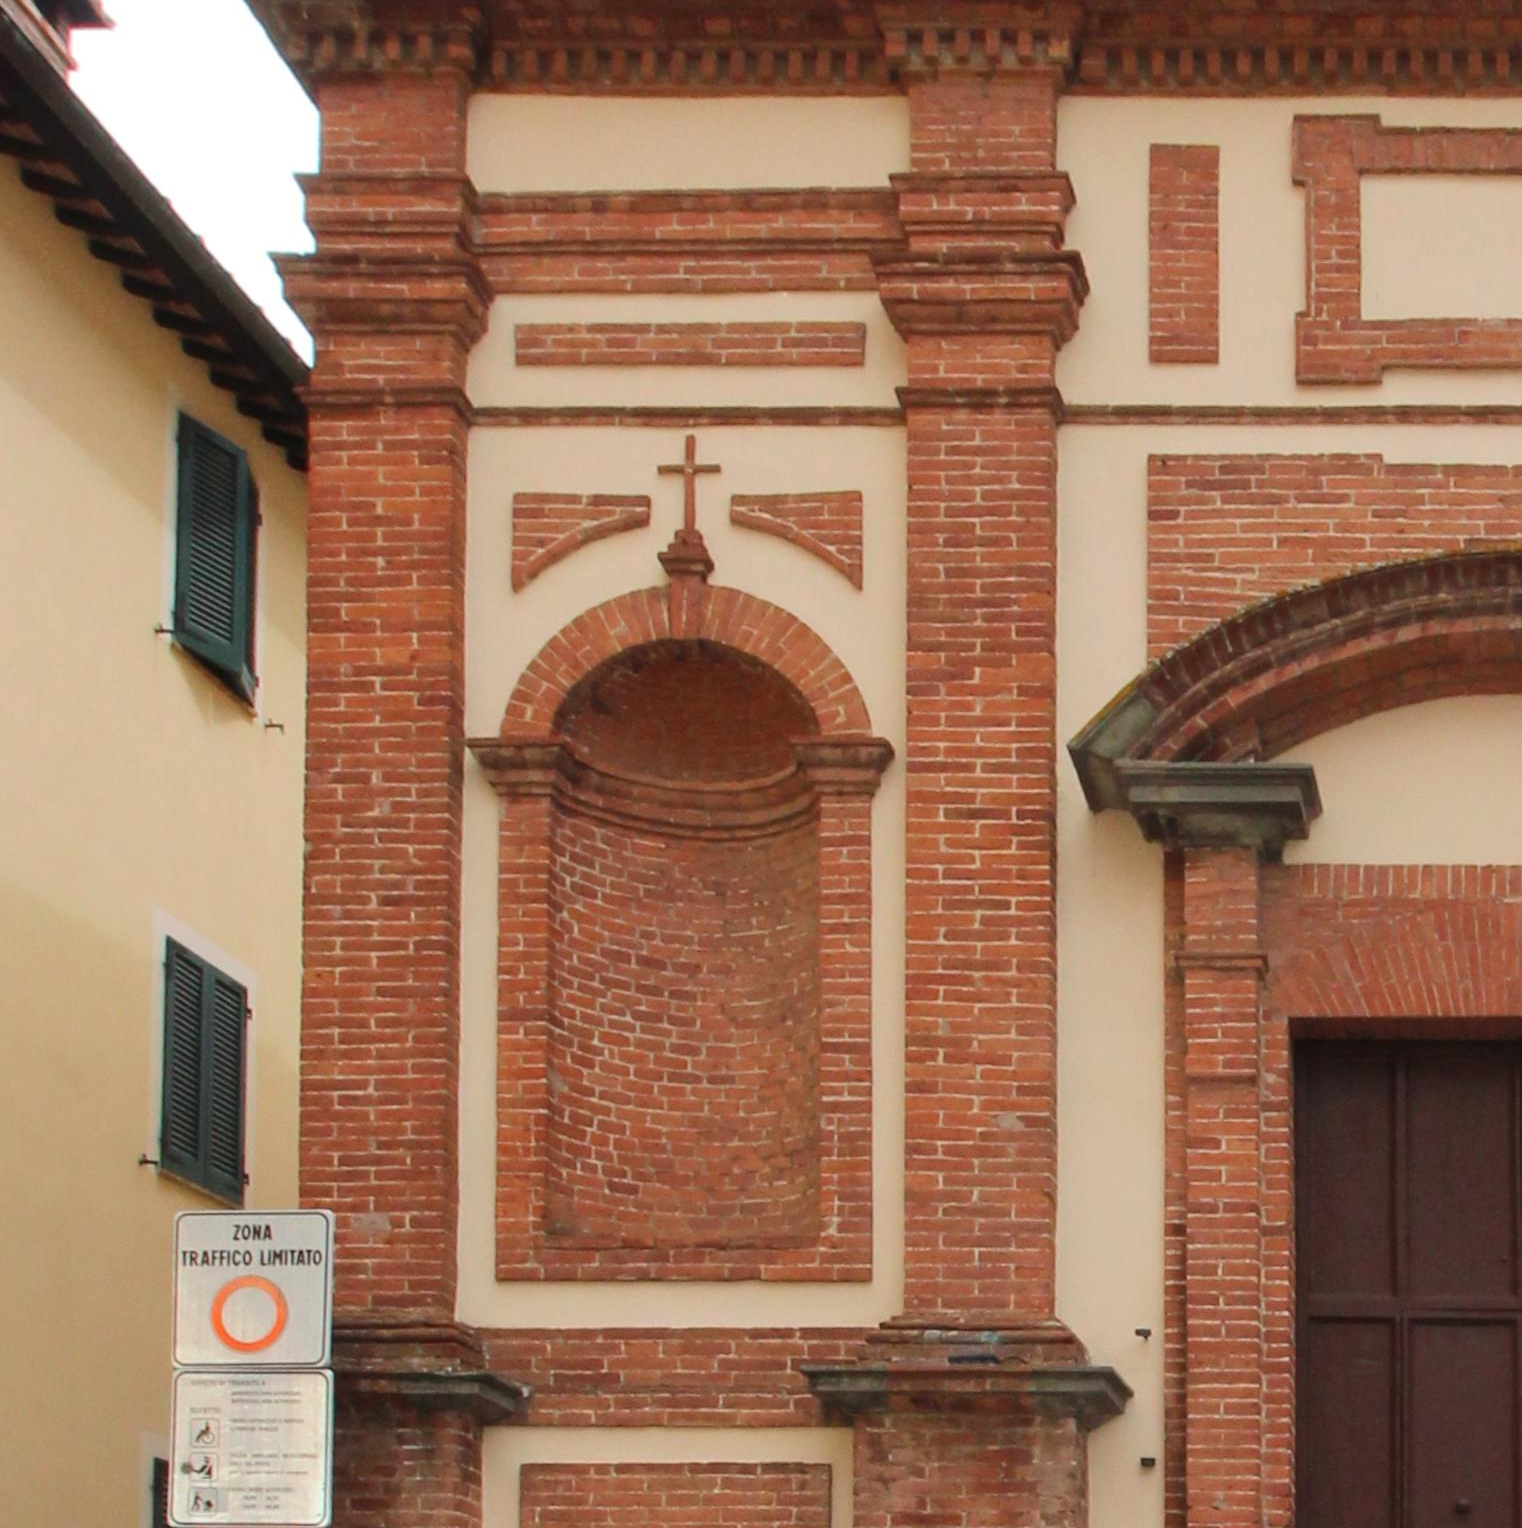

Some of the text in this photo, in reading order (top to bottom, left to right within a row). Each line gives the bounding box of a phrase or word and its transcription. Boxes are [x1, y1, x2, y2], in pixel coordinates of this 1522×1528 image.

[232, 1224, 273, 1241] ZONA
[181, 1249, 323, 1267] TRAFFICO LIMITATO
